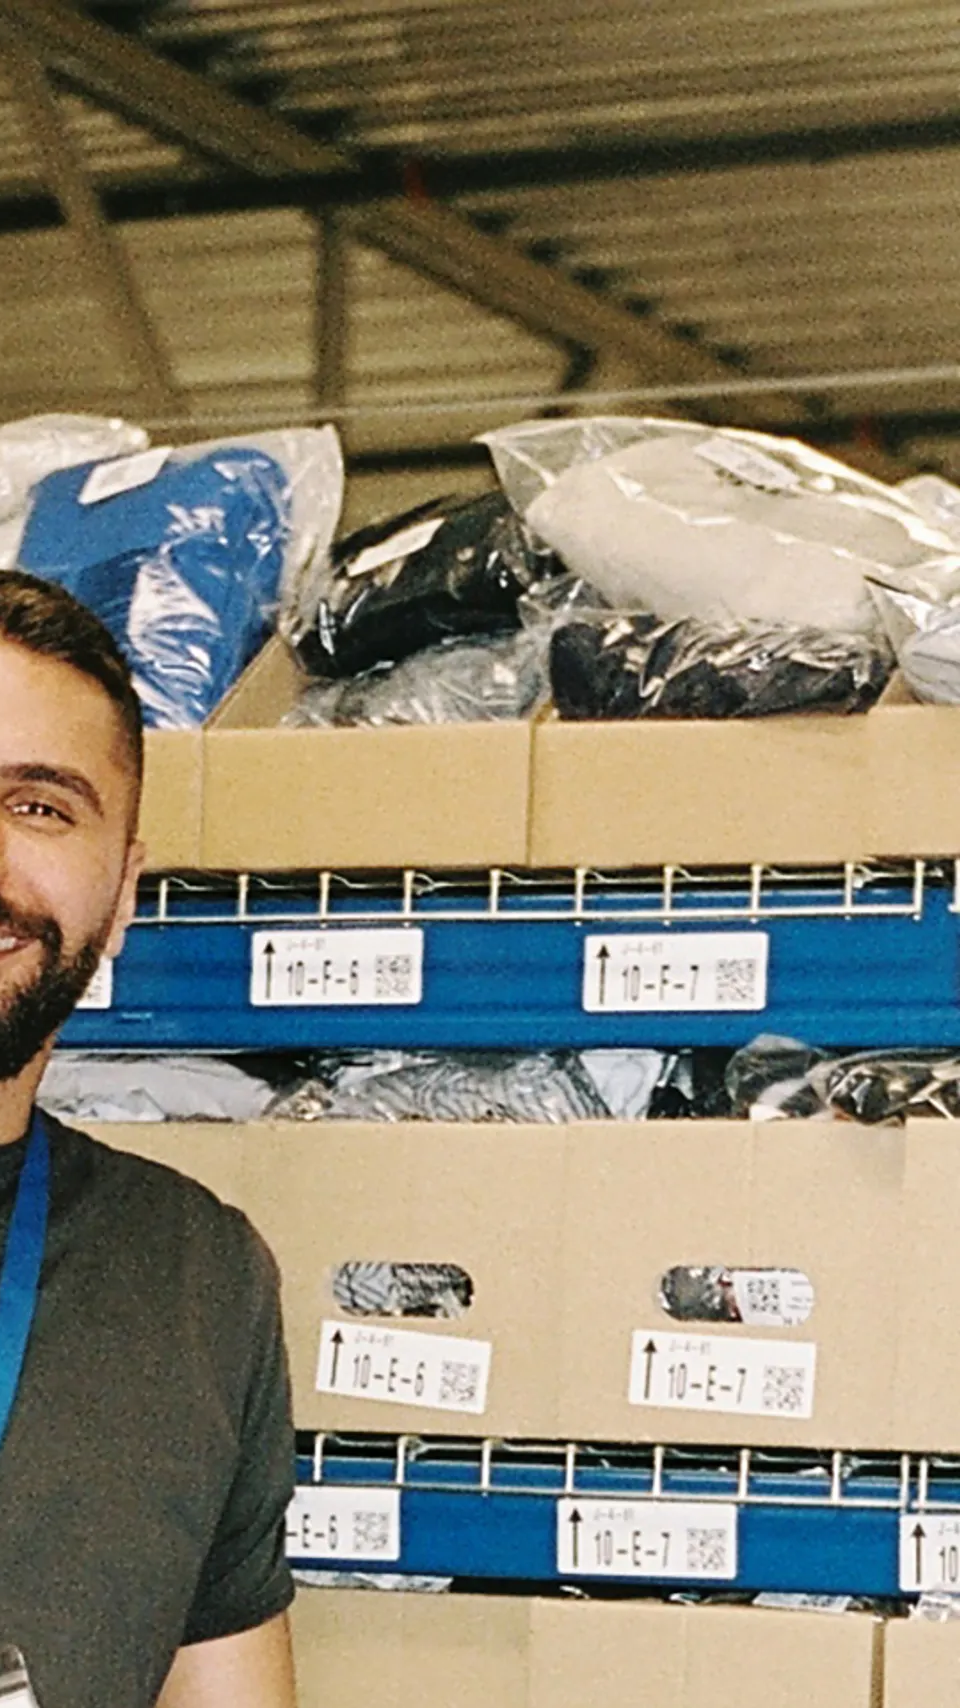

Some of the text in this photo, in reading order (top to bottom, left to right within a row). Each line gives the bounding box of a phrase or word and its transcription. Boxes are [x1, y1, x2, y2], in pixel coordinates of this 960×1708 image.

[286, 959, 360, 998] 10-F-6
[621, 963, 700, 1003] 10-F-7
[352, 1353, 426, 1398] 10-E-6
[666, 1362, 748, 1405] 10-E-7
[287, 1512, 339, 1550] -E-6
[594, 1529, 671, 1569] 10-E-7
